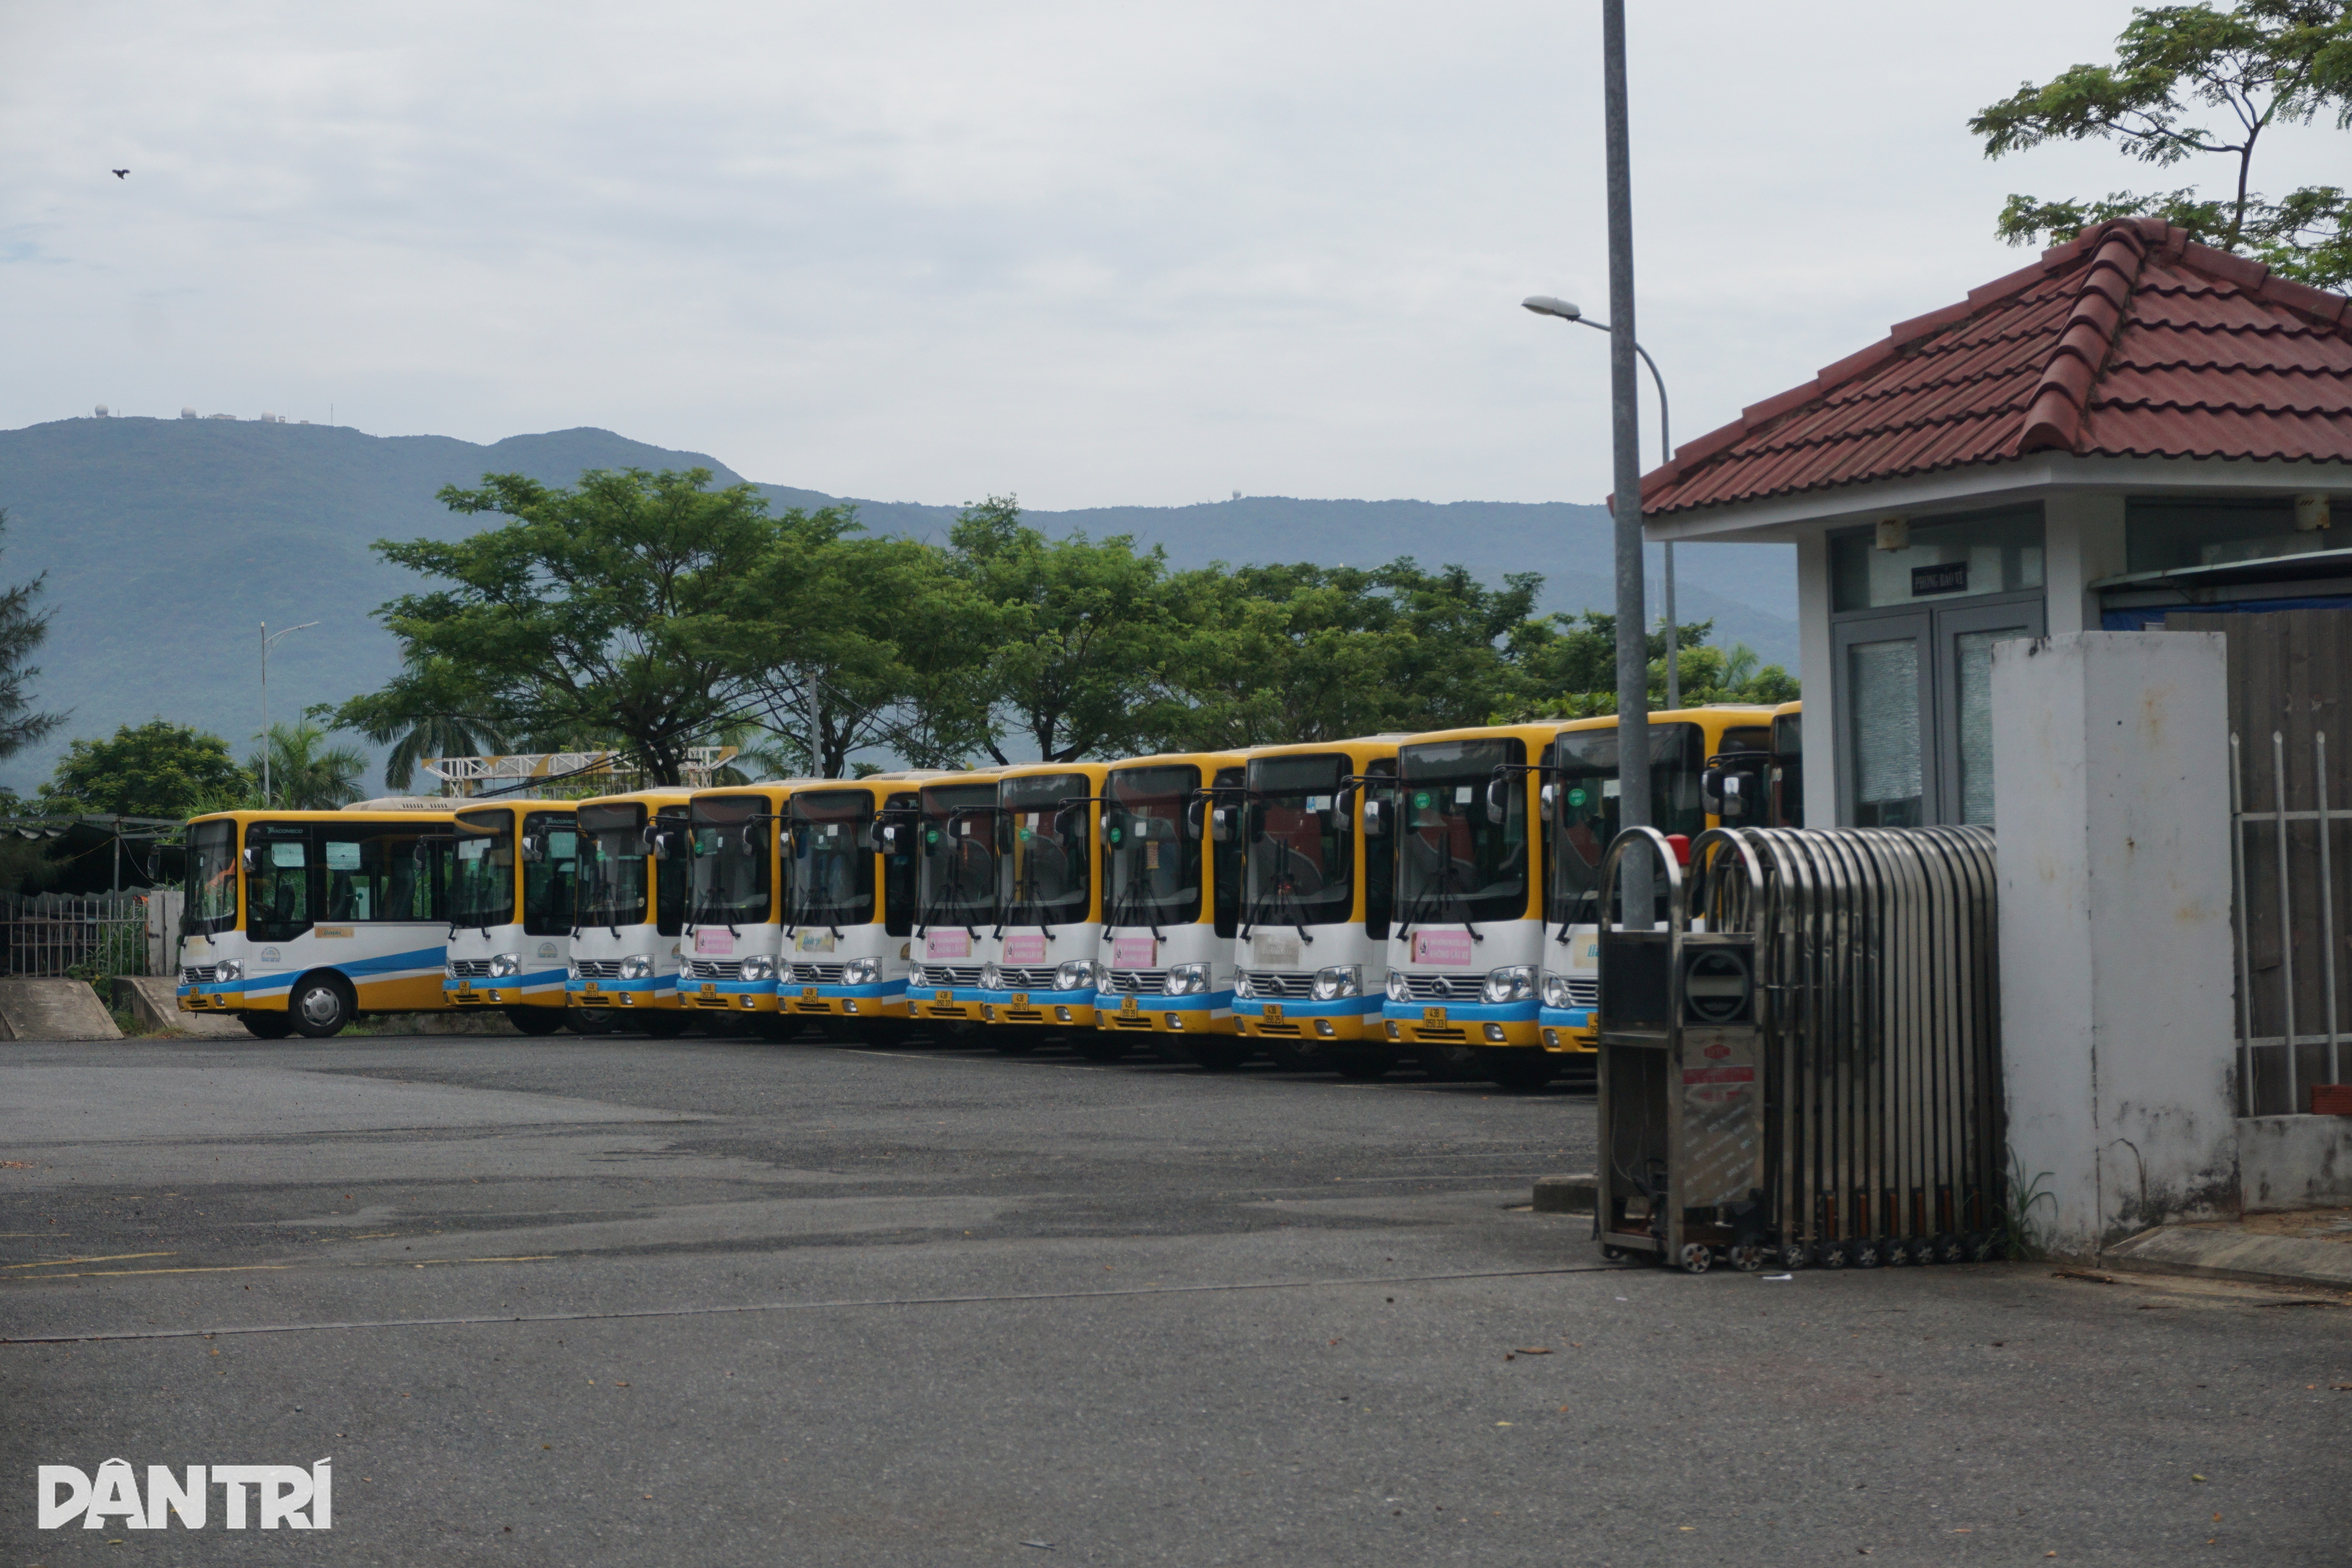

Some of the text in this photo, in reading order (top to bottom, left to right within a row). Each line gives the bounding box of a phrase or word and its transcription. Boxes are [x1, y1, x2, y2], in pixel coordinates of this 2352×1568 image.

[1915, 572, 1939, 589] PHÒNG
[1430, 1008, 1439, 1017] 43B
[1426, 1019, 1443, 1028] 050.33
